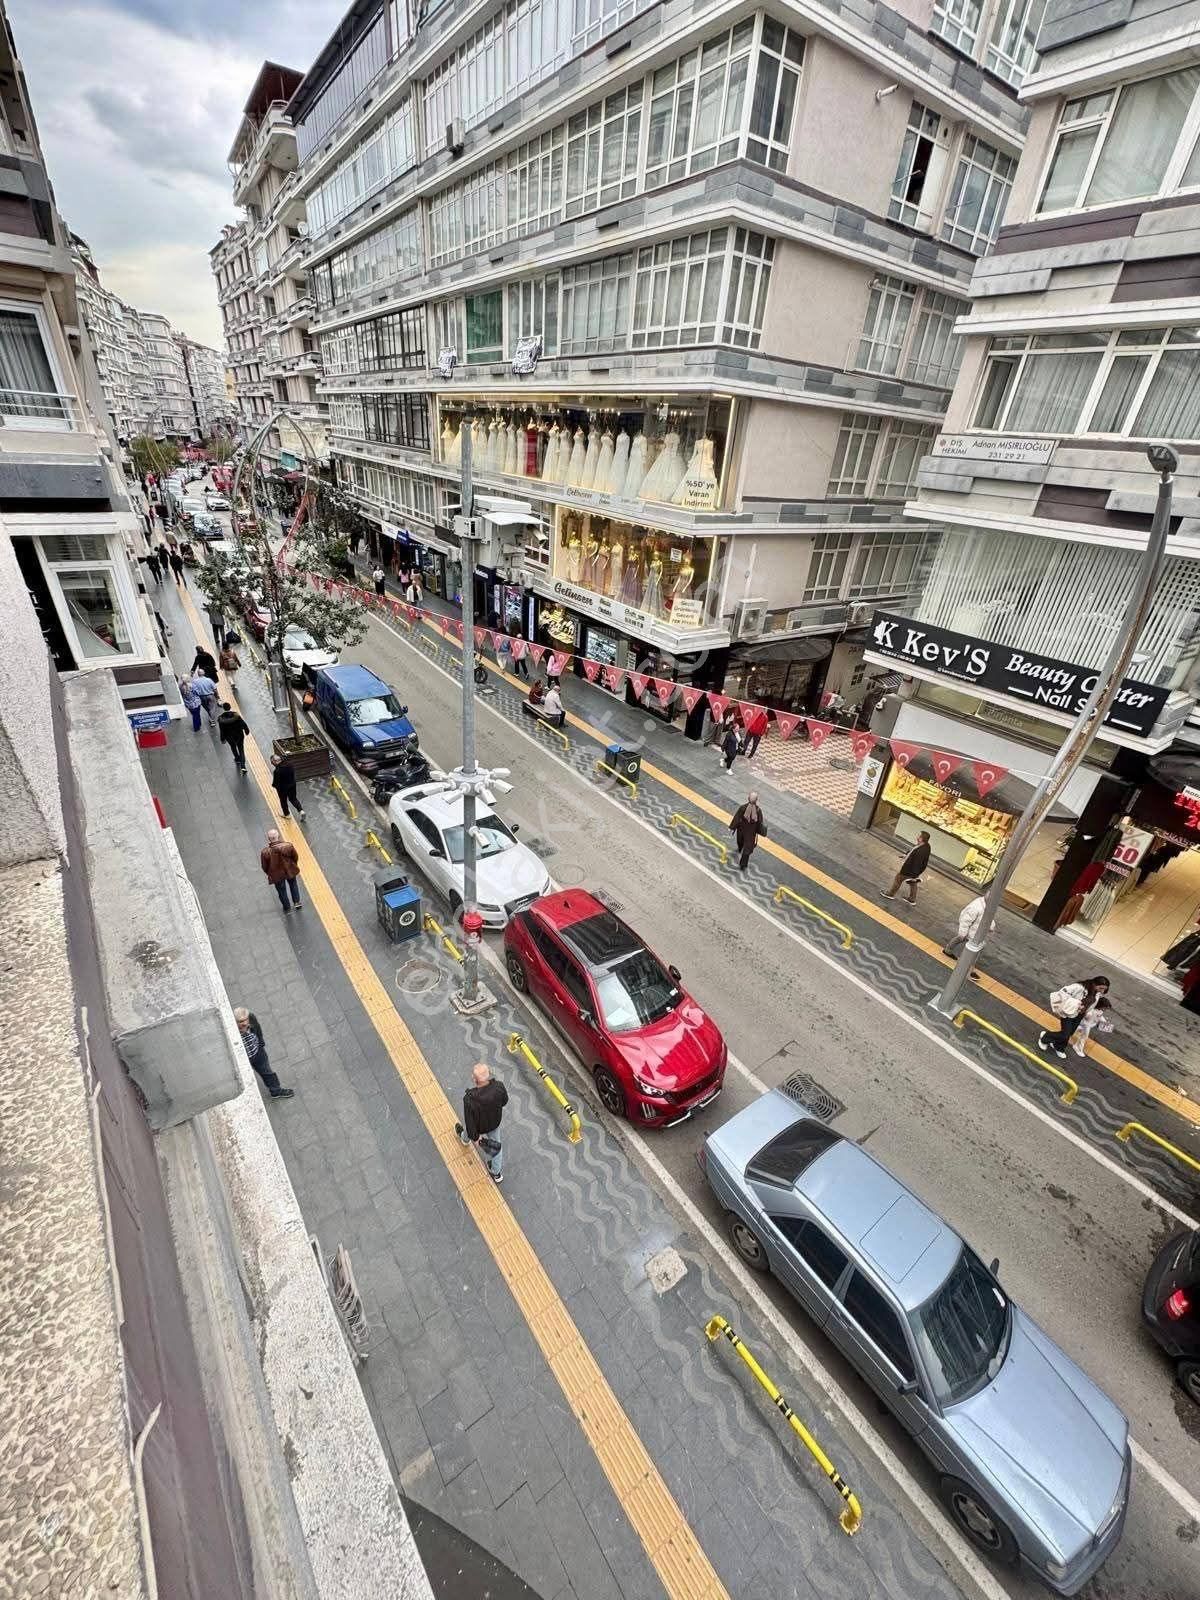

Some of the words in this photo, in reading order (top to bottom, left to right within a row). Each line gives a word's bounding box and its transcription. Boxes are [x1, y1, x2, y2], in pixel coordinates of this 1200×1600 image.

[688, 489, 710, 498] Varan
[902, 628, 990, 676] Kev'S
[1005, 653, 1077, 694] Beauty
[1034, 685, 1073, 709] Nail
